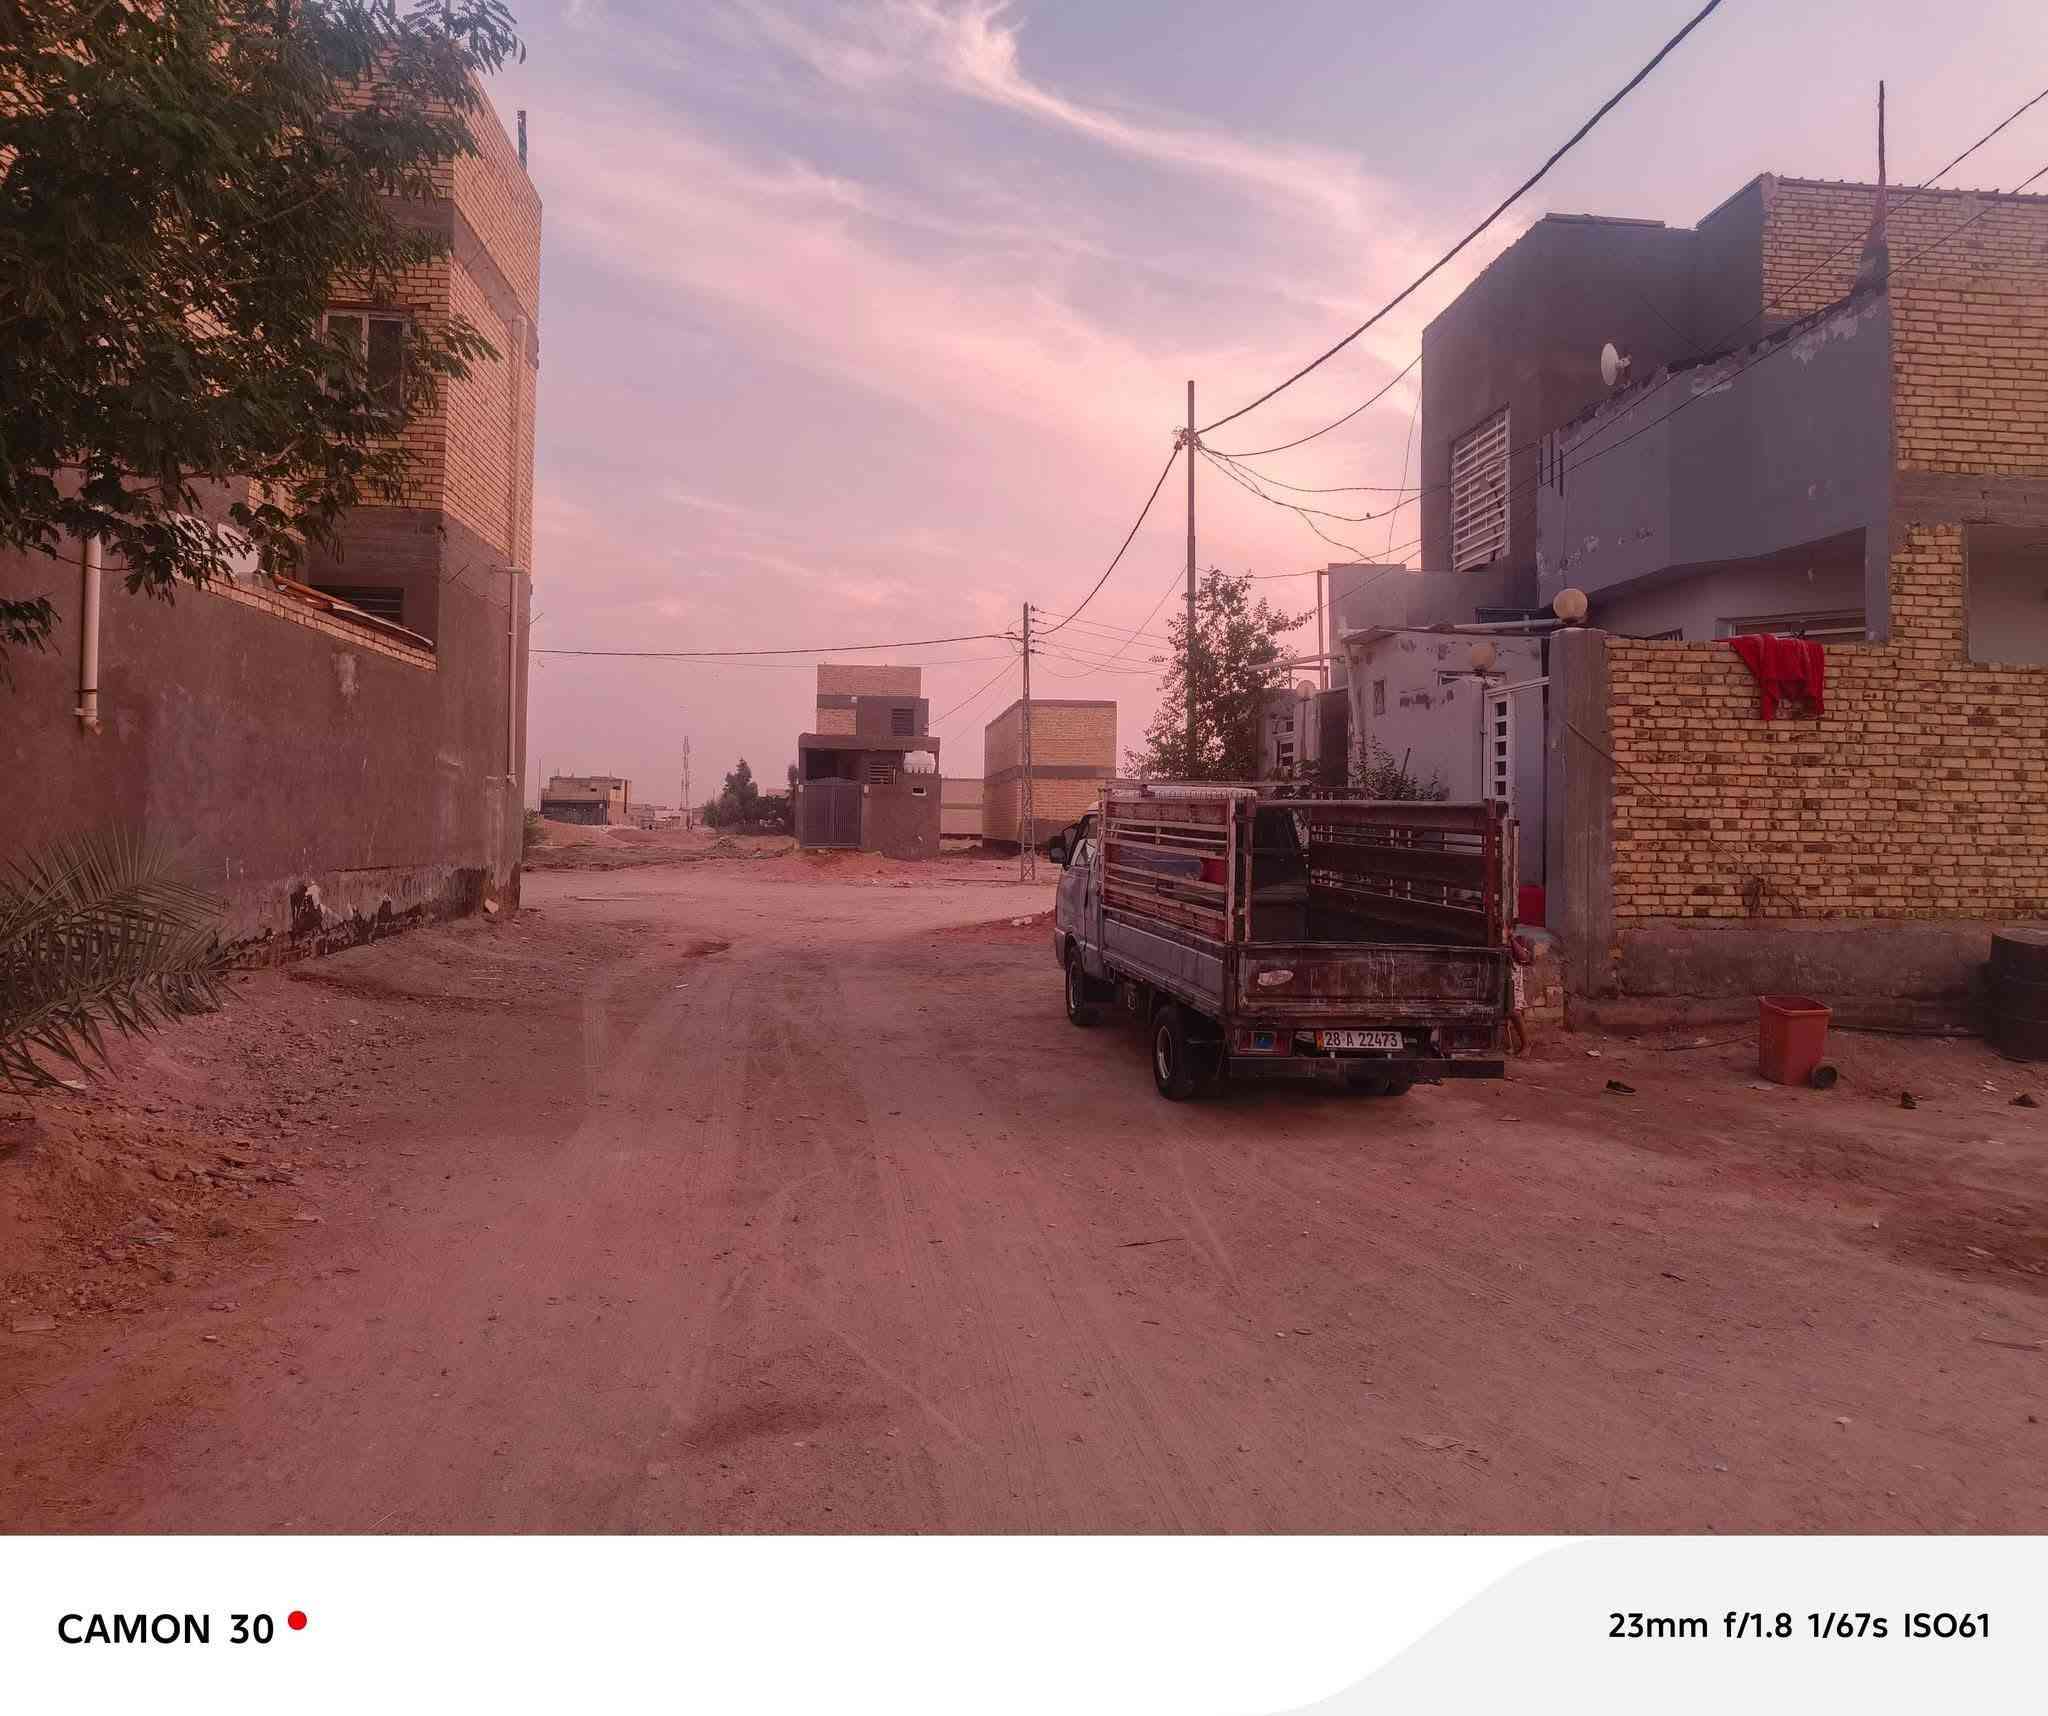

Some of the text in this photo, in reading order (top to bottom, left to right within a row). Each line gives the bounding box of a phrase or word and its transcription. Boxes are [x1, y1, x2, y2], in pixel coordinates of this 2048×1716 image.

[1325, 1032, 1341, 1047] 28
[1346, 1032, 1354, 1047] A
[1358, 1032, 1398, 1047] 22473
